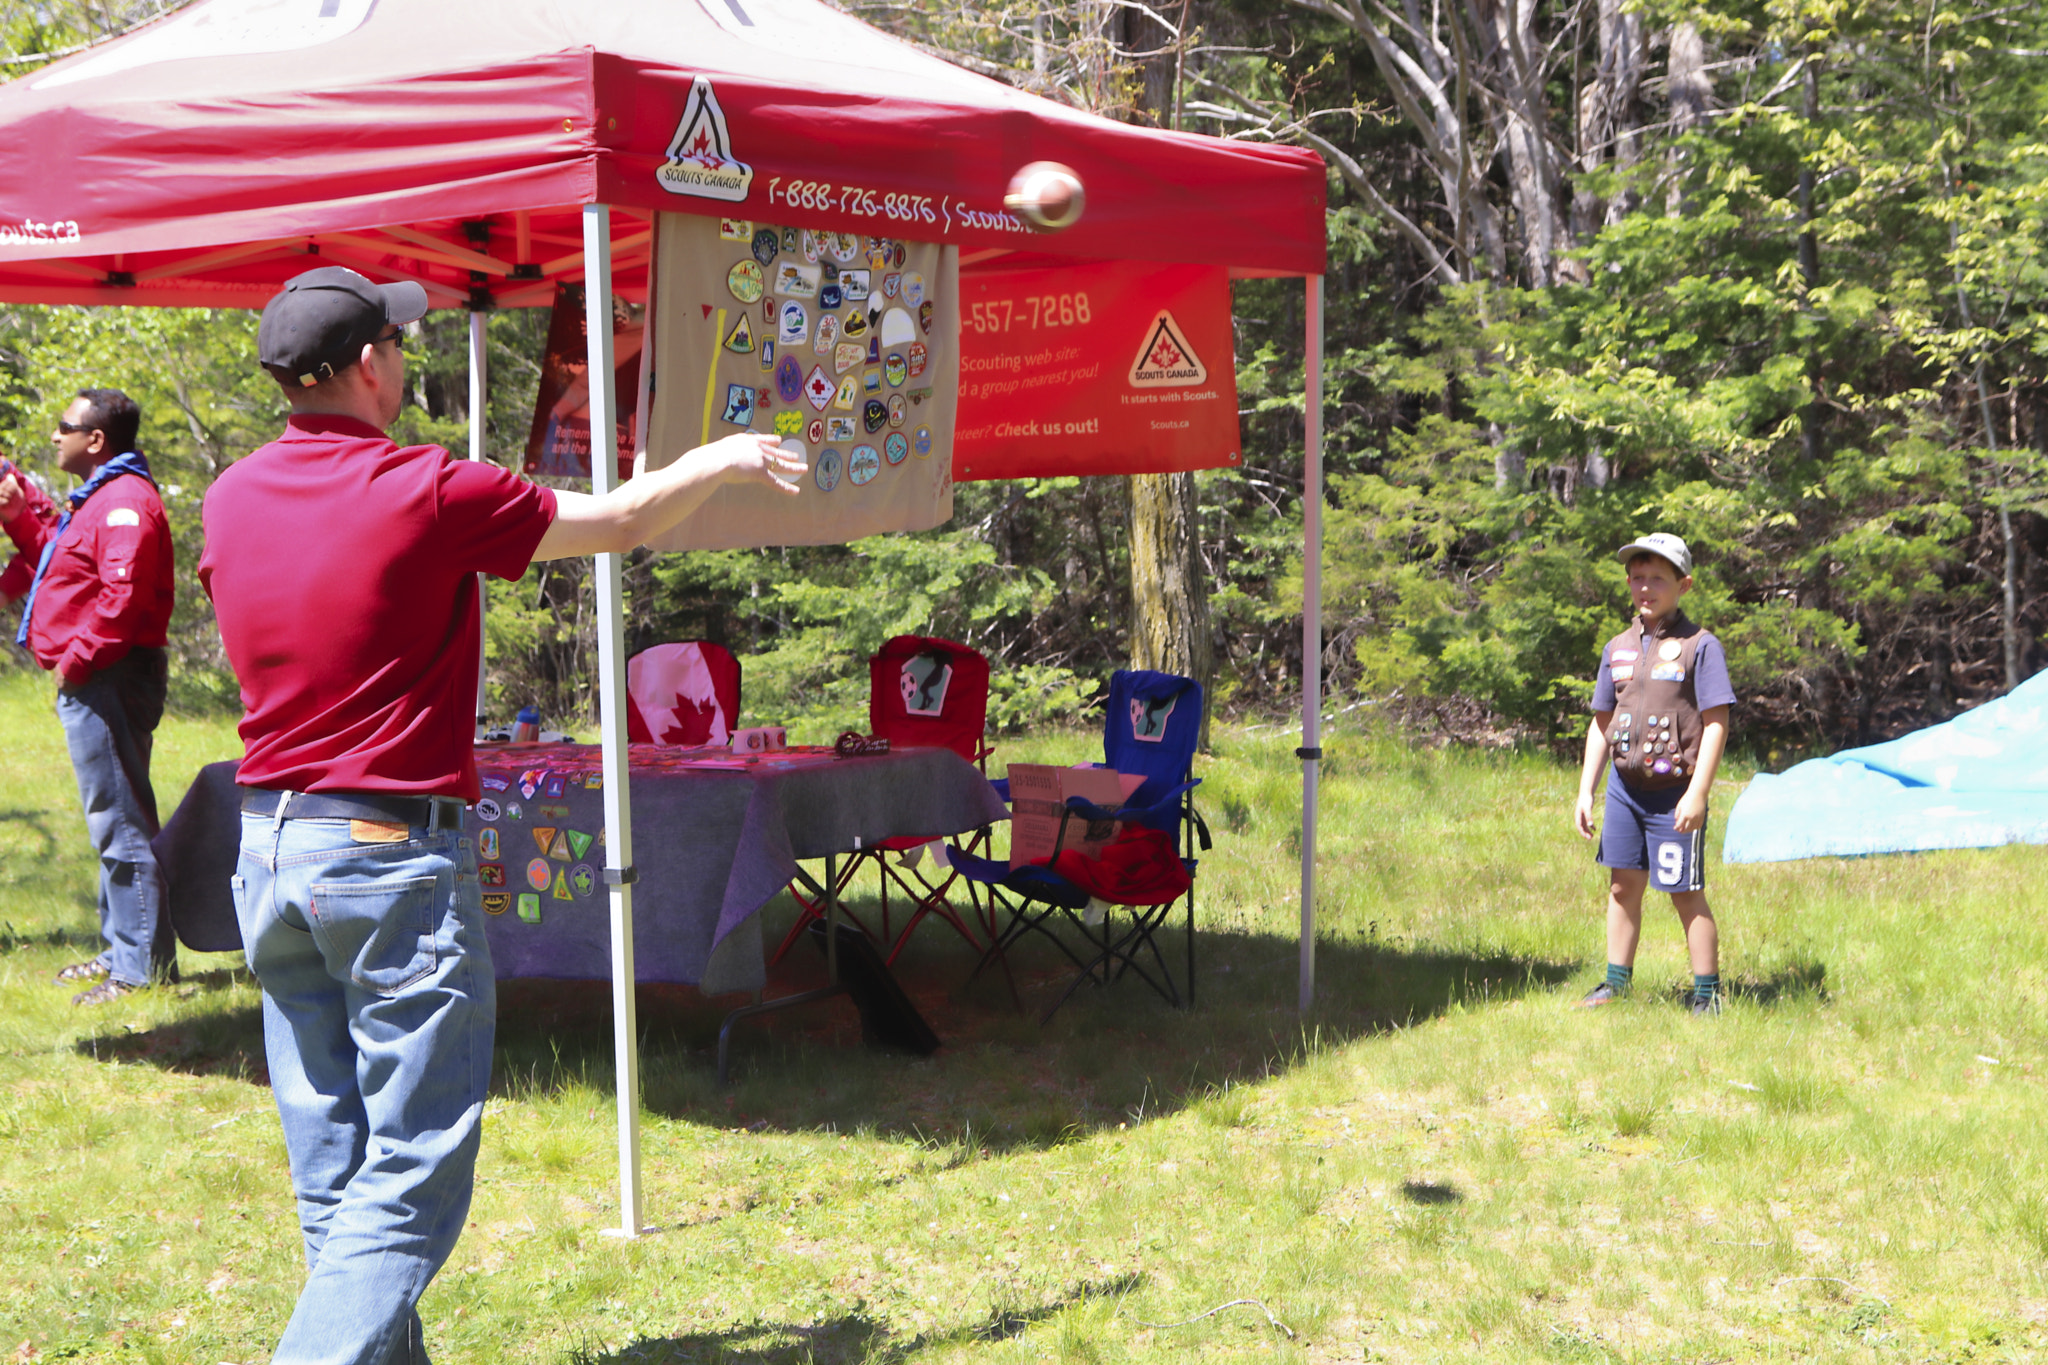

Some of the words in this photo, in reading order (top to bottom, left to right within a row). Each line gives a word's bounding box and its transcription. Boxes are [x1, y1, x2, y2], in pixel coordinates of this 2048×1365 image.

[664, 168, 702, 185] SCOUTS
[704, 174, 743, 190] CANADA
[768, 177, 936, 223] 1-888-726-8876
[955, 201, 1038, 234] Scouts.
[0, 218, 81, 245] outs.ca
[958, 291, 1092, 335] -557-7268
[960, 353, 1021, 373] Scouting
[1024, 347, 1053, 366] web
[970, 383, 979, 396] a
[980, 379, 1020, 399] group
[1021, 369, 1068, 389] nearest
[1067, 362, 1100, 385] you!
[1135, 370, 1165, 380] SCOUTS
[1166, 369, 1199, 379] CANADA
[1121, 394, 1129, 404] It
[1131, 394, 1158, 404] starts
[1159, 392, 1181, 402] with
[1182, 390, 1219, 401] Scouts.
[555, 425, 591, 439] Remem
[953, 425, 992, 441] nteer?
[994, 420, 1039, 437] Check
[1043, 423, 1061, 435] us
[1064, 417, 1099, 434] out!
[1150, 420, 1190, 430] Scouts.ca
[551, 439, 571, 454] and
[570, 441, 587, 455] the
[1657, 841, 1684, 886] 9
